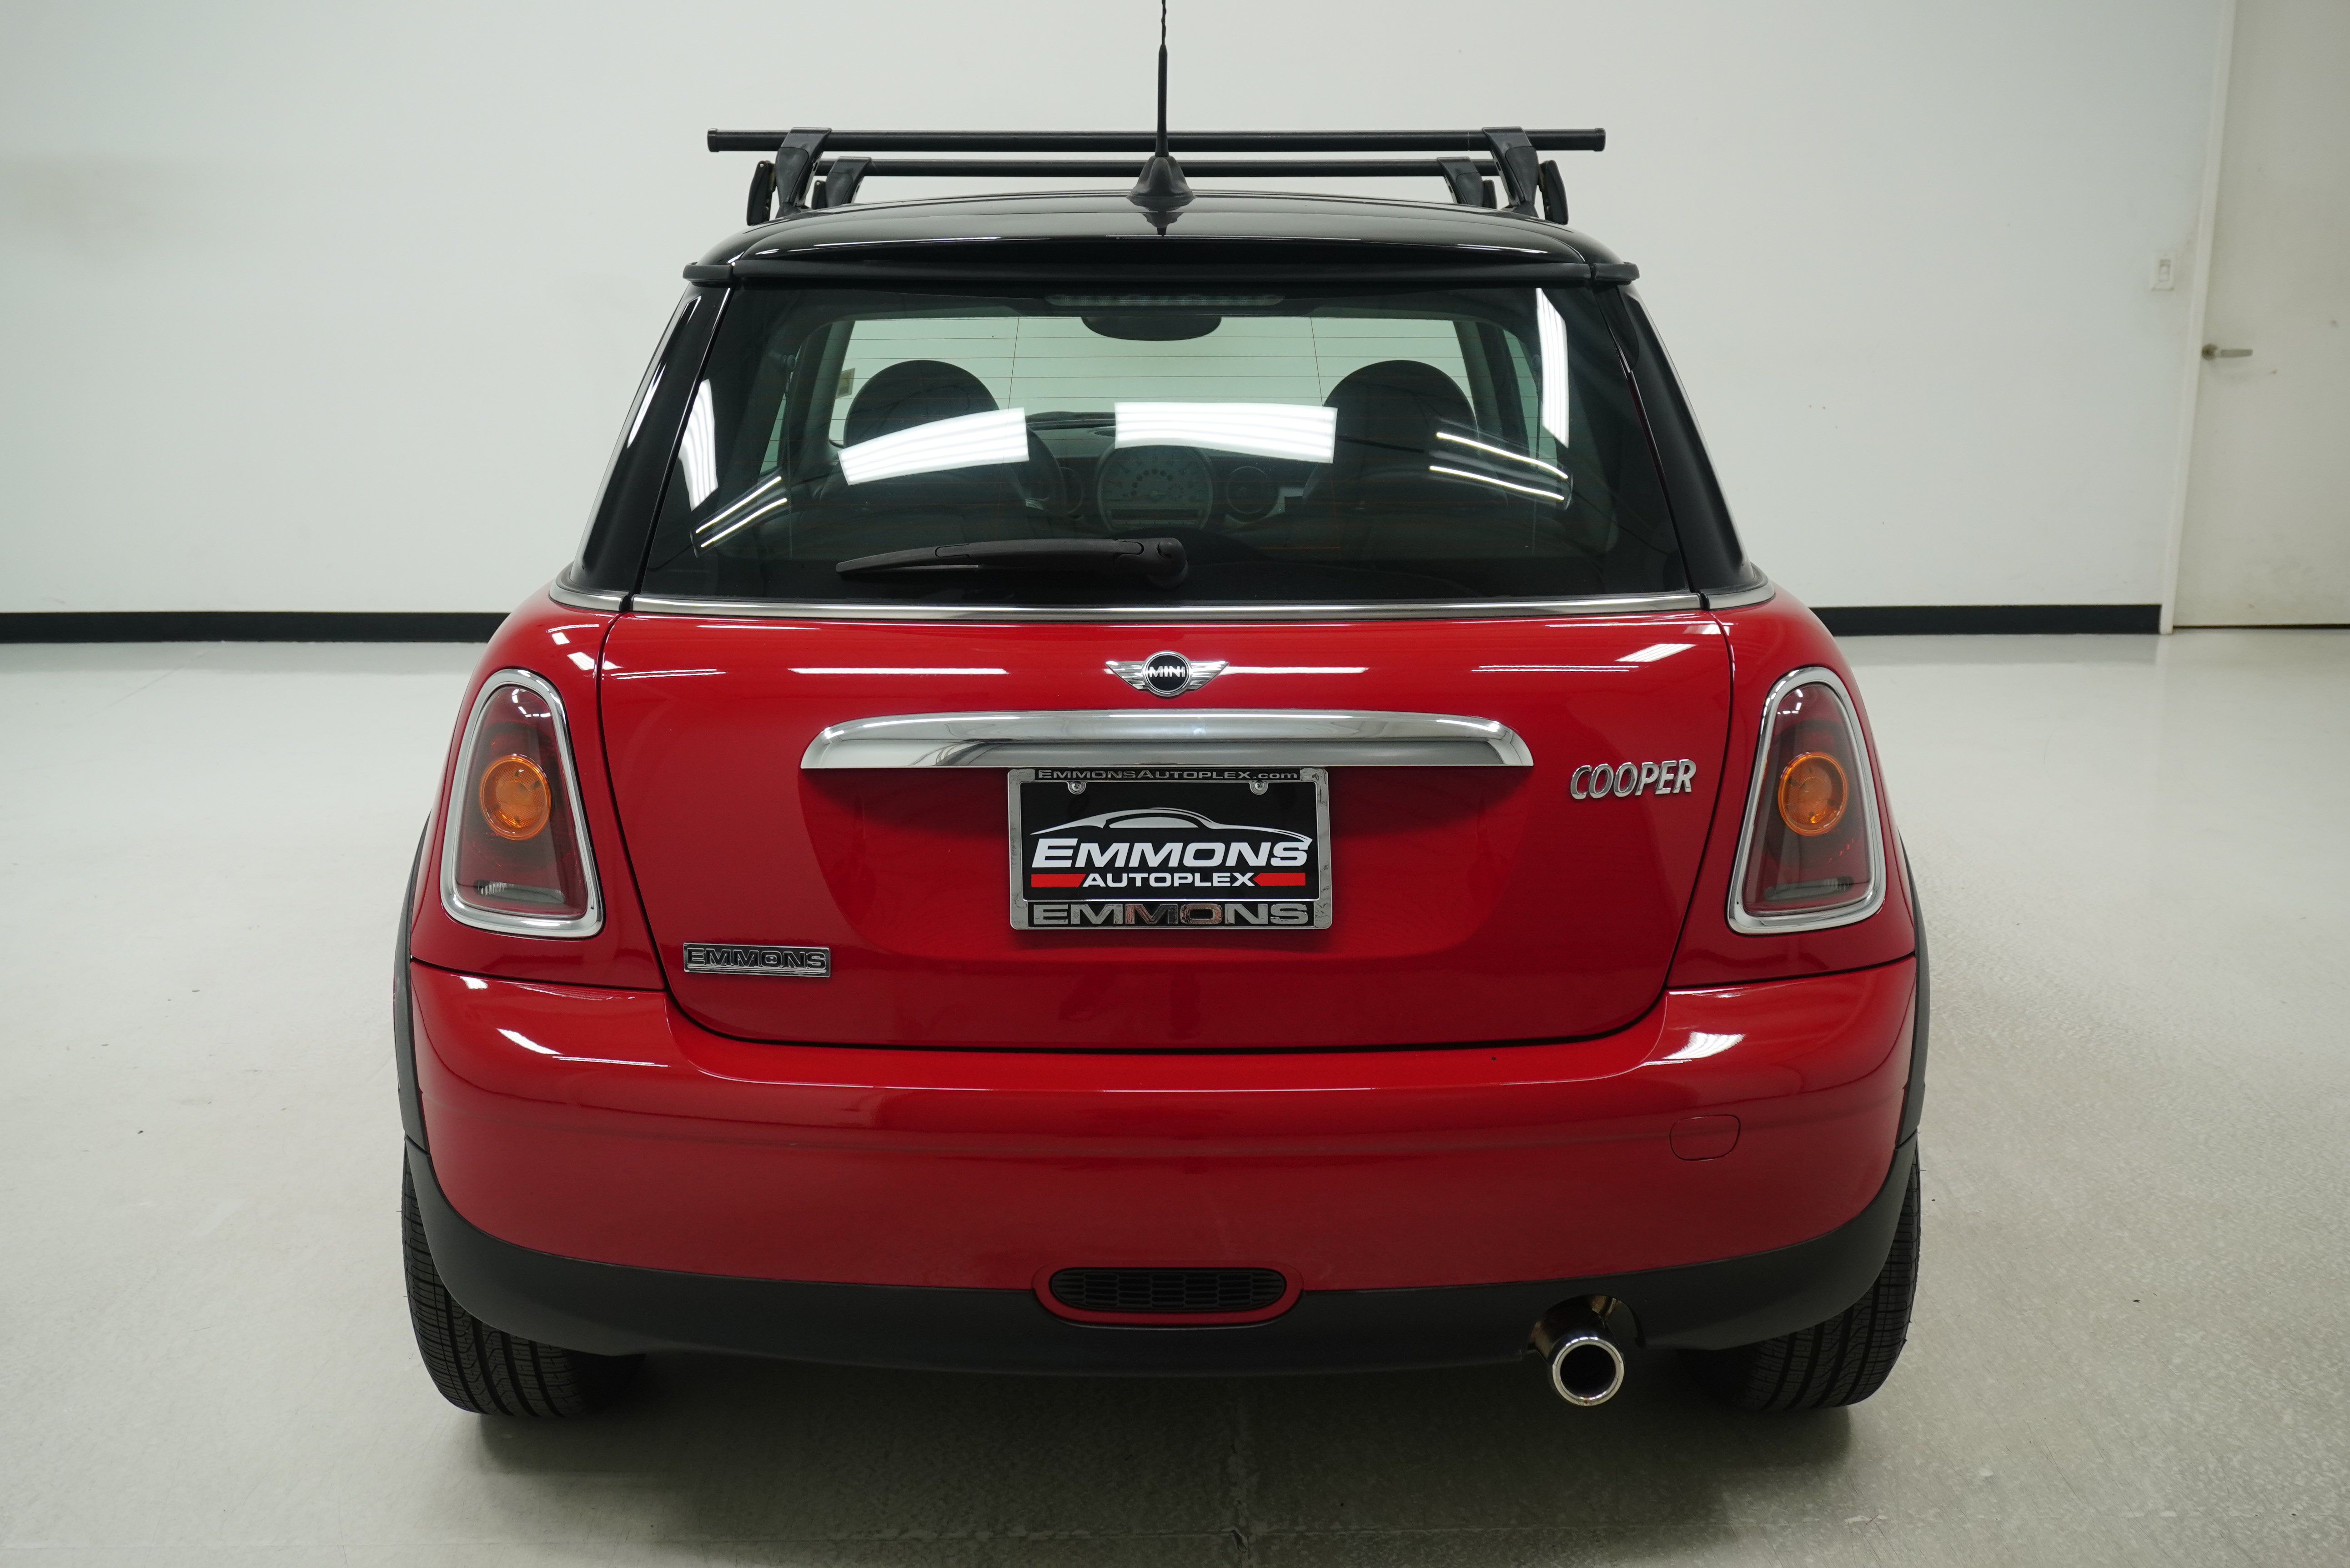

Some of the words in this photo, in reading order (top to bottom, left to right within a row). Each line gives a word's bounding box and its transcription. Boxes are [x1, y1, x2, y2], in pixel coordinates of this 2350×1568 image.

[1149, 666, 1185, 677] MINI
[1570, 759, 1696, 799] COOPER
[1031, 838, 1312, 868] EMMONS
[1082, 873, 1255, 887] AUTOPLEX
[1034, 903, 1309, 925] EMMONS
[687, 948, 826, 970] EMMONS
